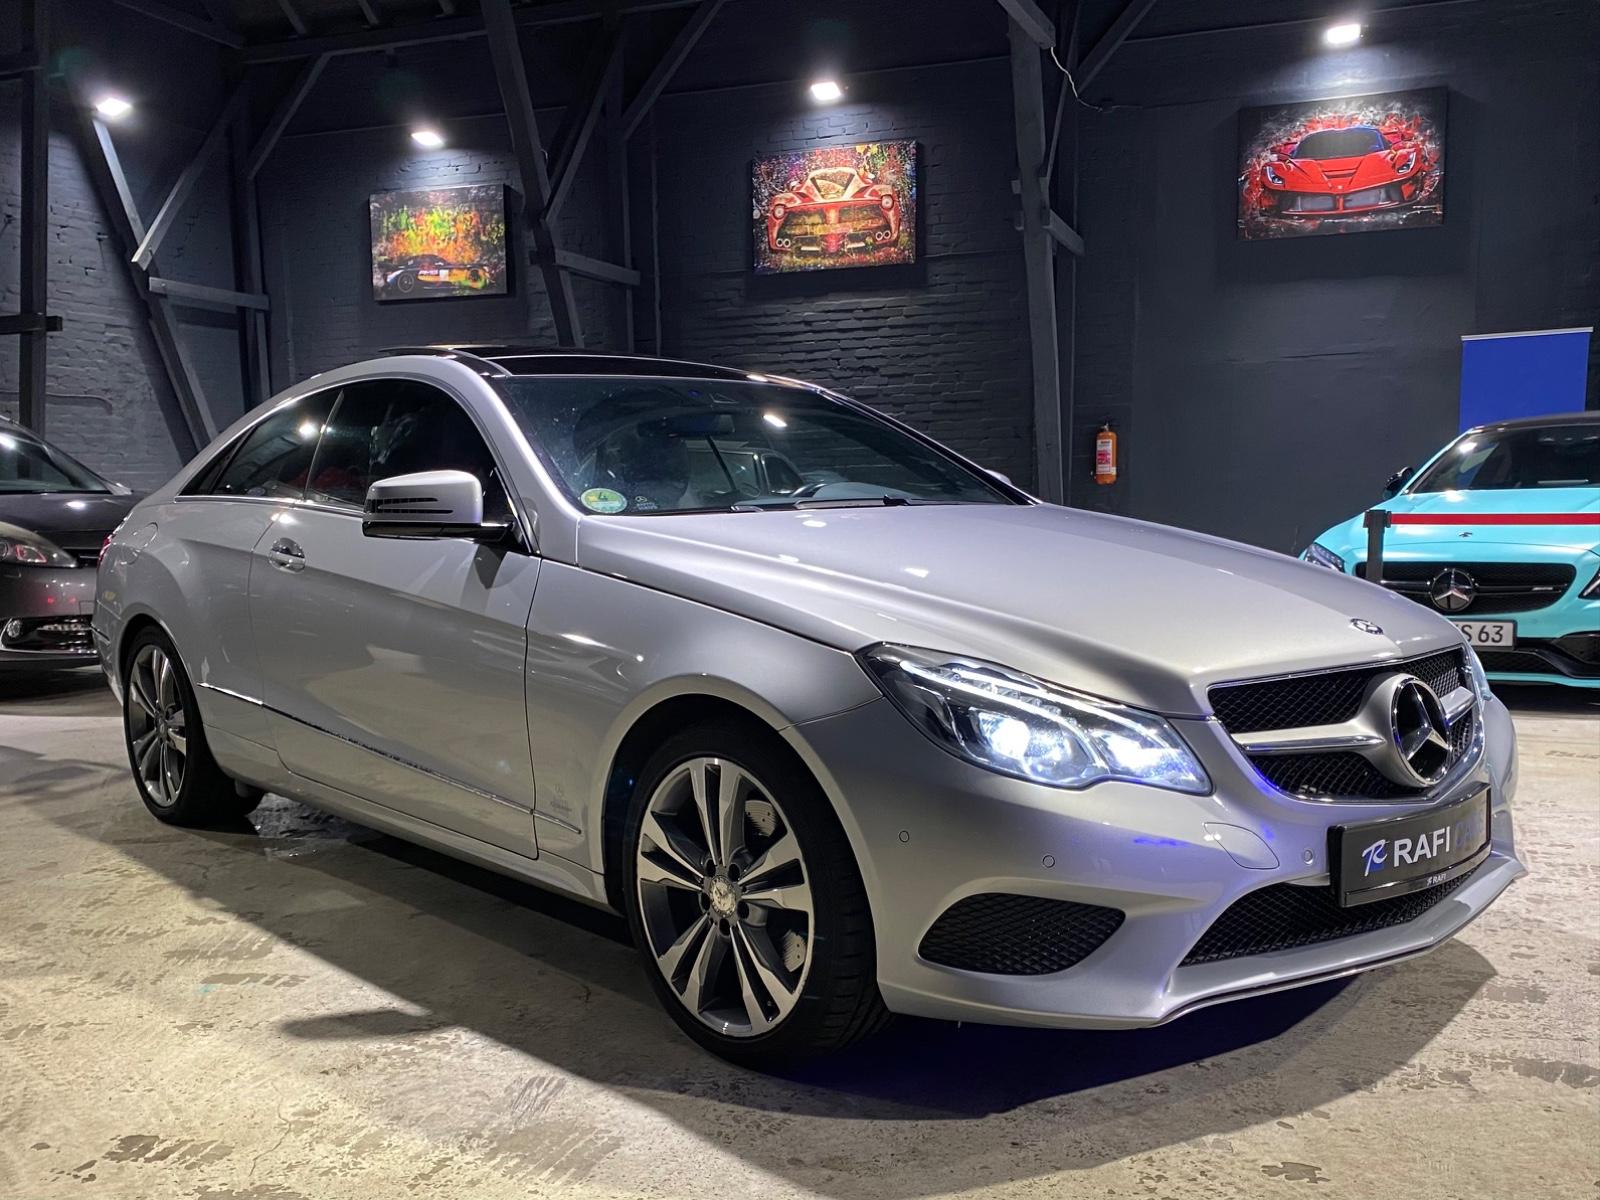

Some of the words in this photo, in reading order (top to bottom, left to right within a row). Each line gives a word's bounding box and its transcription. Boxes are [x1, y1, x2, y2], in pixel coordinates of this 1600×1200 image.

[1456, 624, 1472, 642] S
[1478, 625, 1504, 643] 63
[1393, 826, 1450, 867] RAFI
